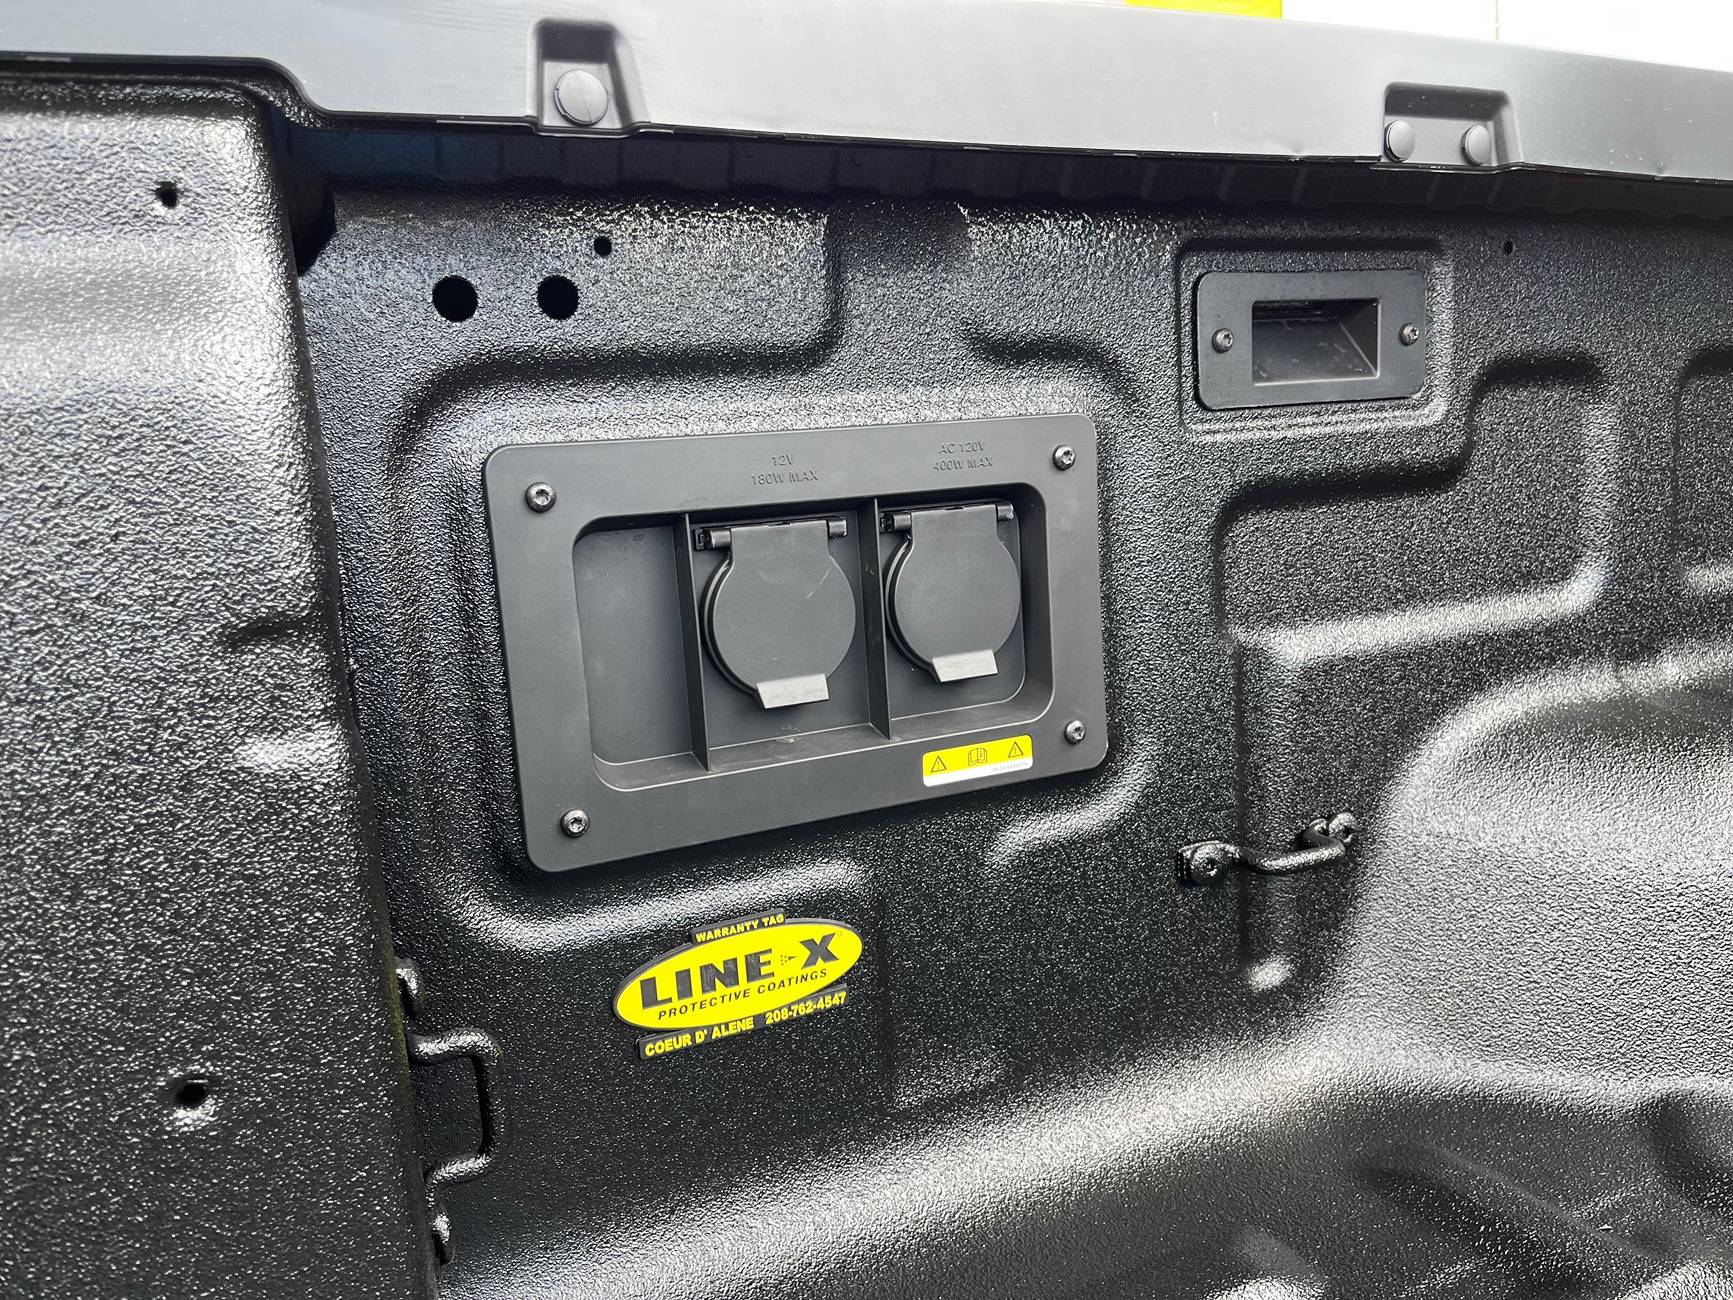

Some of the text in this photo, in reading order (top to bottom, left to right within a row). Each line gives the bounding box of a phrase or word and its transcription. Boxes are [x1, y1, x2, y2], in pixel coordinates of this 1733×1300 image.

[938, 441, 984, 454] AC 120V
[771, 454, 793, 466] 12V
[933, 456, 993, 471] 400W MAX
[751, 469, 818, 485] 180W MAX
[695, 913, 785, 942] WARRANTY TAG
[658, 968, 828, 1020] PROTECTIVE COATINGS
[645, 1033, 692, 1057] COEUR
[711, 1016, 755, 1039] ALENE
[765, 991, 847, 1025] 208-762-4547
